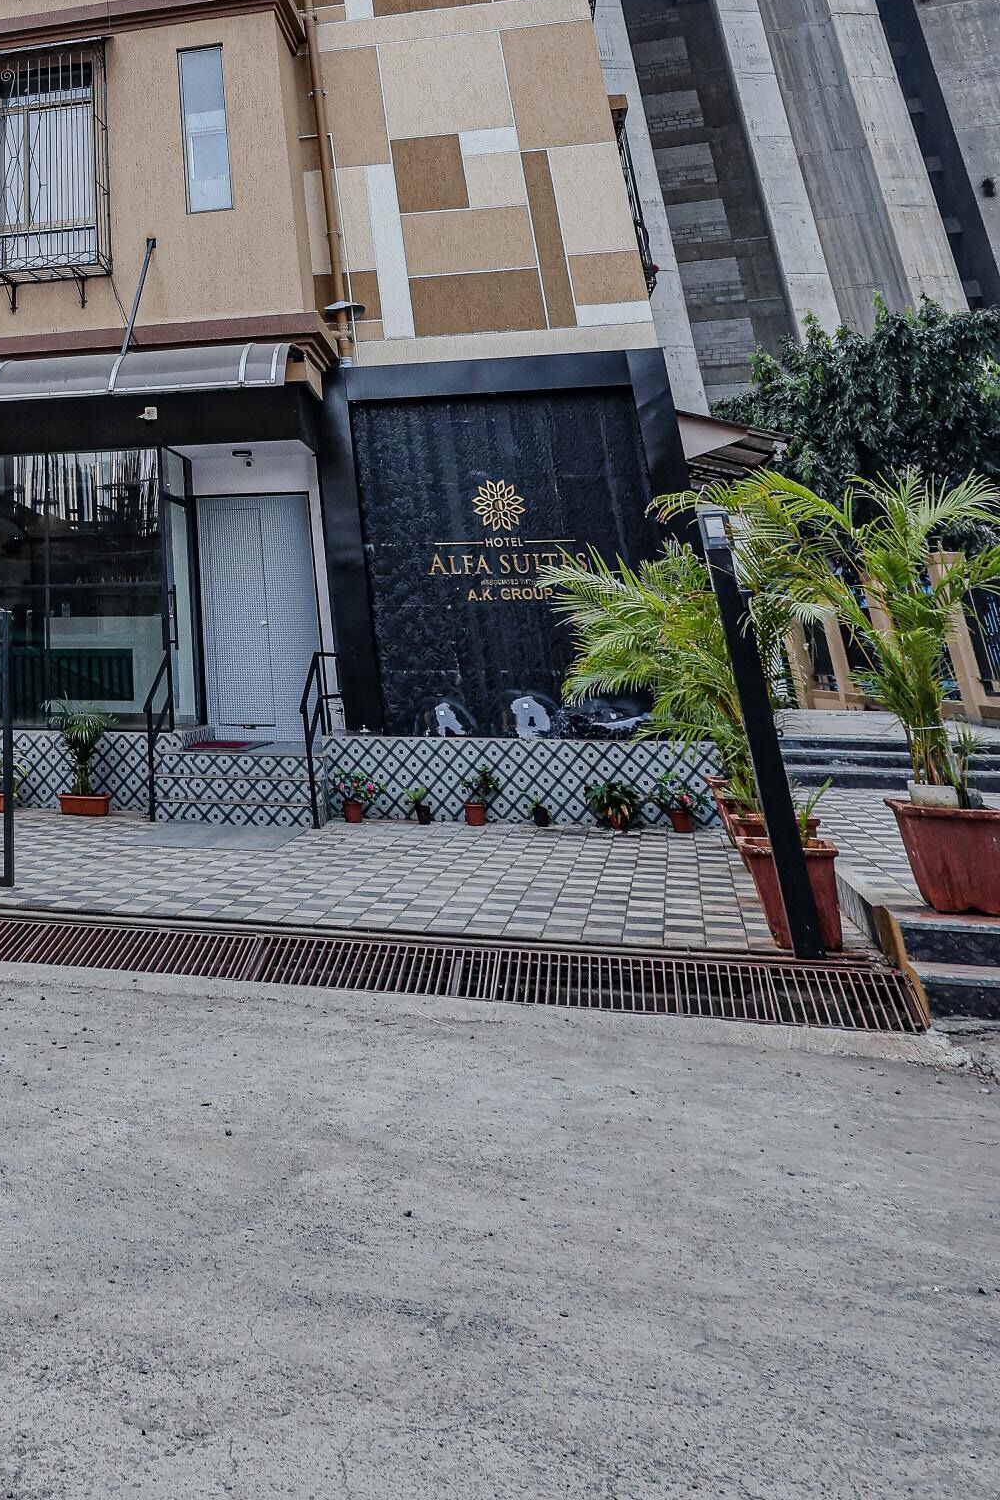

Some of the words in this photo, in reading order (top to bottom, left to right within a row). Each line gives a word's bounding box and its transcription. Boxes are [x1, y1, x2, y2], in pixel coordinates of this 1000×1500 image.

[485, 537, 524, 548] HOTEL
[428, 553, 493, 575] ALFA
[467, 588, 497, 601] A.K.
[500, 587, 553, 600] GROUP
